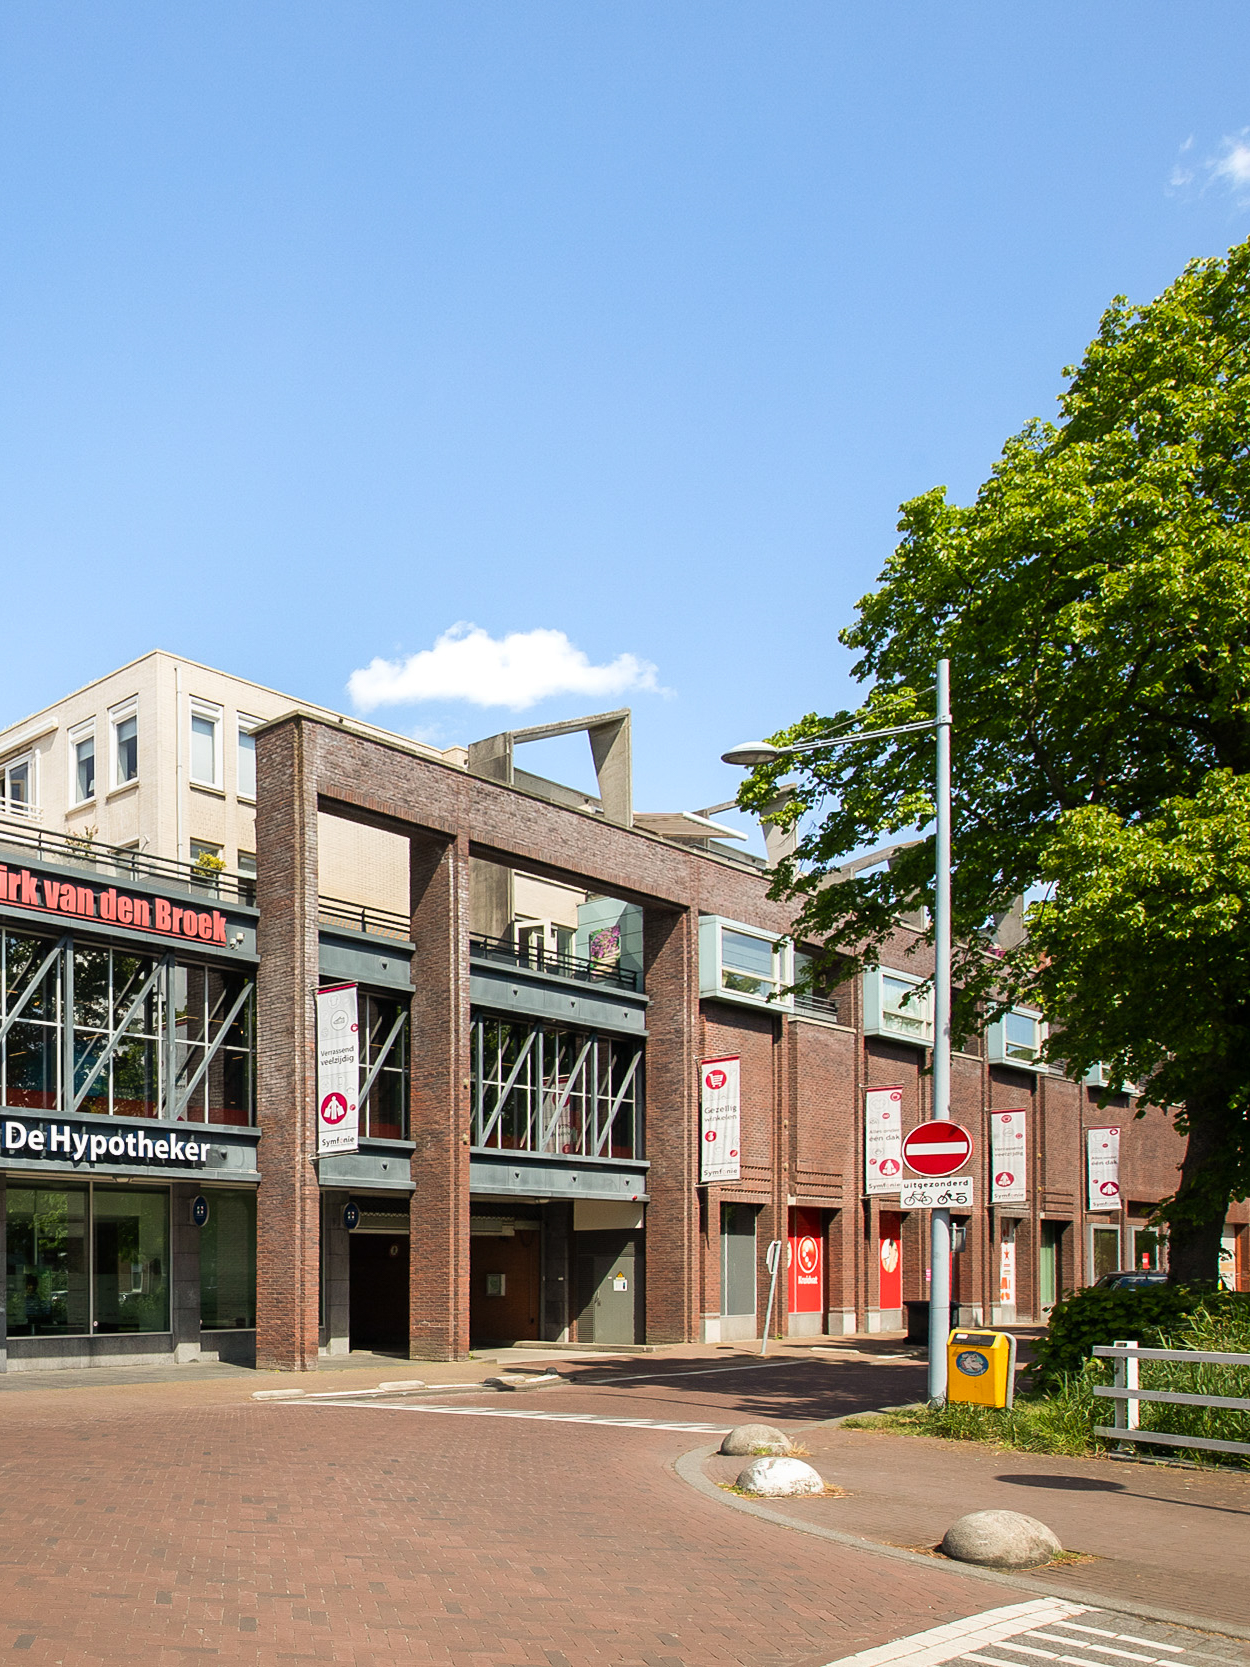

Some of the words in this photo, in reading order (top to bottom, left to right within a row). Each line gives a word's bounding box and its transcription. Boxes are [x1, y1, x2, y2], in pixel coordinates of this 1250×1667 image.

[43, 880, 94, 916] van
[99, 888, 150, 927] den
[154, 898, 227, 943] Broek
[320, 1045, 355, 1057] Verrassend
[320, 1055, 355, 1066] veelzijdig
[704, 1104, 737, 1114] Gezellig
[704, 1114, 737, 1122] winkelen
[4, 1121, 45, 1150] De
[49, 1125, 211, 1161] Hypotheker
[322, 1136, 355, 1147] Symfonie
[903, 1180, 969, 1189] uitgezonderd
